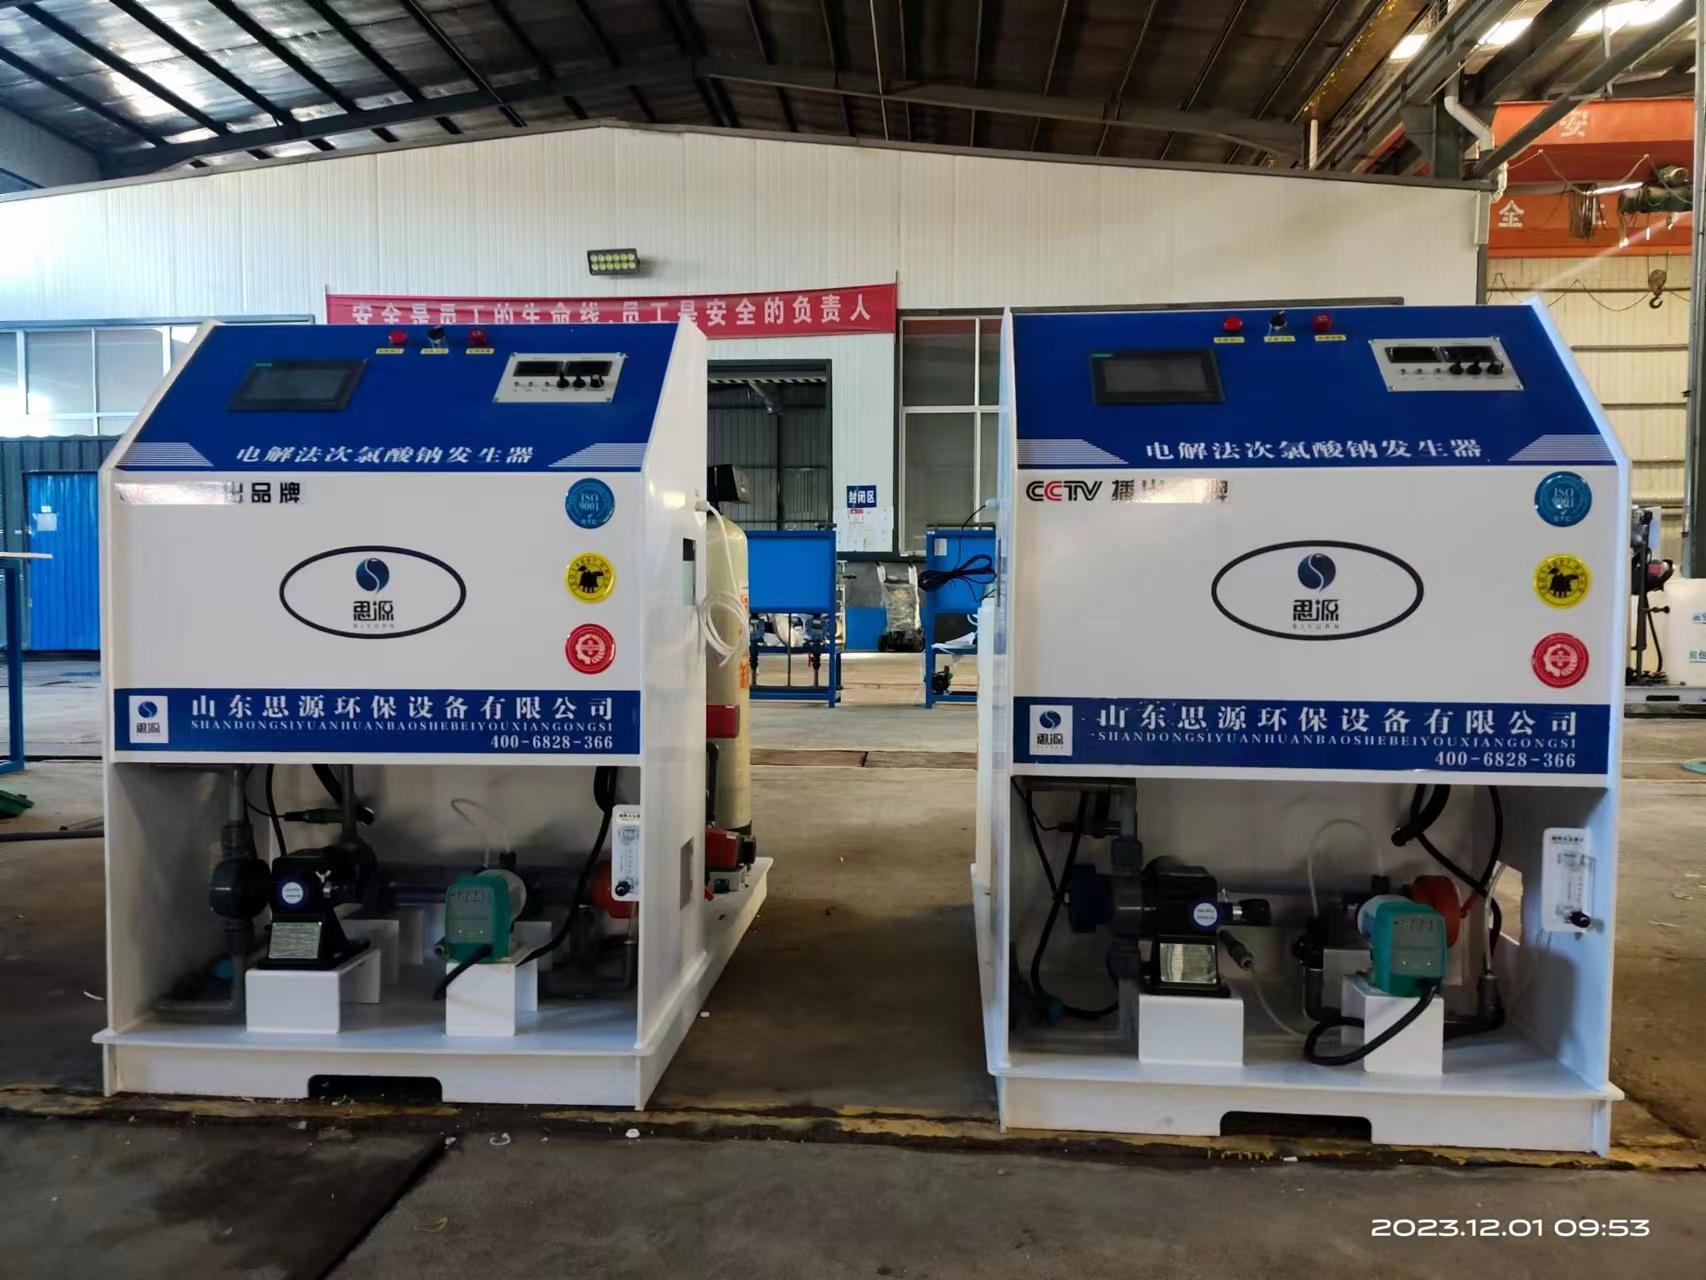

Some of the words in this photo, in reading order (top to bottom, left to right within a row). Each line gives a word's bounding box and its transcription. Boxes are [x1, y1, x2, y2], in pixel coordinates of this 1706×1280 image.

[236, 445, 535, 465] 电解法次氯酸钠发生器
[1146, 438, 1483, 460] 电解法次氯酸钠发生器
[848, 490, 876, 504] 封闭区
[1026, 480, 1102, 501] CCTV
[353, 600, 394, 621] 思源
[1293, 599, 1339, 621] 思源
[192, 694, 613, 720] 山东思源环保设备有限公司
[192, 720, 613, 732] SHANDONGSIYUANHUANBAOSHEBEIYOUXIANGONGSI
[1100, 704, 1577, 736] 山东思源环保设备有限公司
[490, 735, 613, 749] 400-6828-366
[1098, 732, 1576, 748] SHANDONGSIYUANHUANBAOSHEBEIYOUXIANGONGSI
[1434, 751, 1576, 768] 400-6828-366
